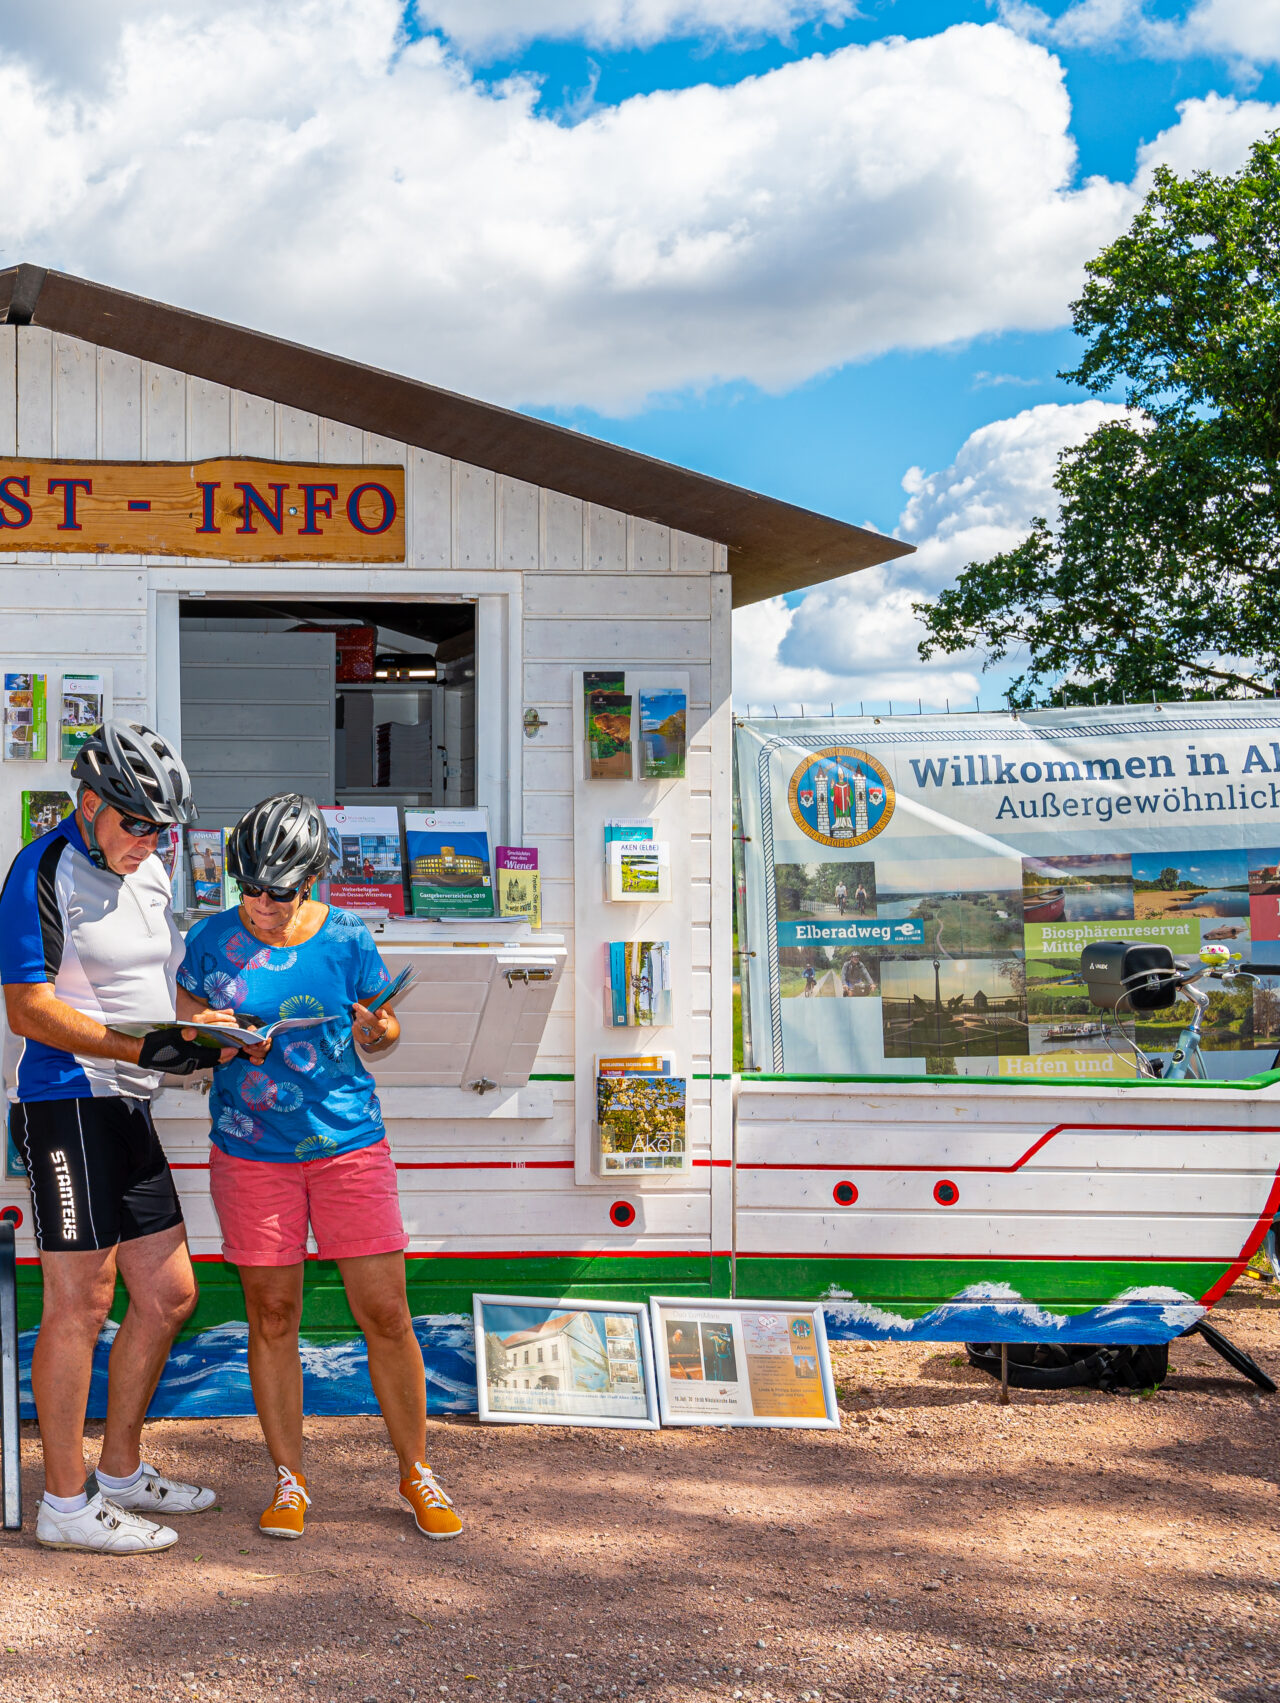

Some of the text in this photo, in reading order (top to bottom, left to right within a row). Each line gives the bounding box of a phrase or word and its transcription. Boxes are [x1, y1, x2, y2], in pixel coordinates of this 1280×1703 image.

[195, 481, 398, 535] INFO
[909, 753, 1177, 789] Willkommen
[1186, 745, 1230, 777] in
[639, 844, 660, 852] (ELBE)
[504, 860, 535, 870] Wiener
[795, 924, 891, 941] Elberadweg
[1041, 923, 1190, 941] Biosphärenreservat
[1006, 1055, 1115, 1075] Hafen und
[631, 1133, 683, 1154] Aken
